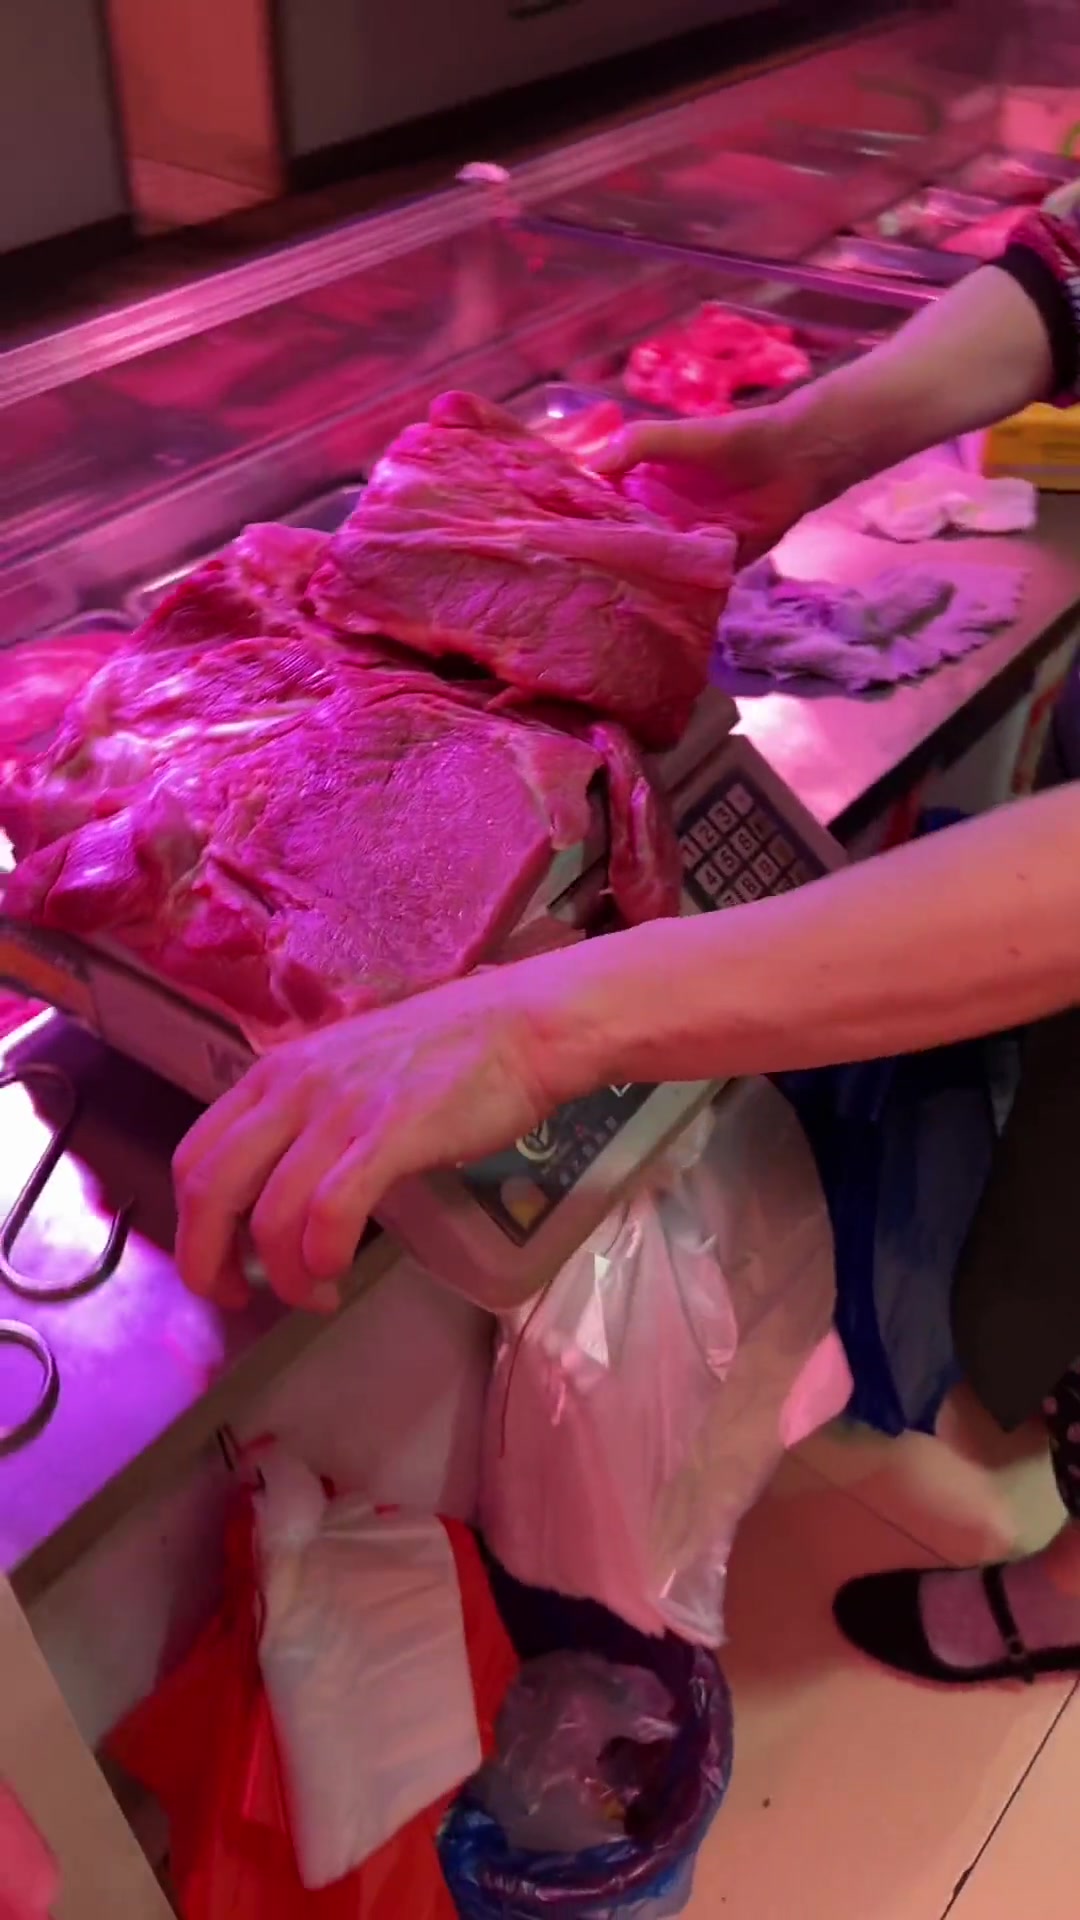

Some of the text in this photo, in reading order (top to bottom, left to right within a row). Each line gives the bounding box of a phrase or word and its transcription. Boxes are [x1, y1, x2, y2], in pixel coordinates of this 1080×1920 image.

[698, 826, 714, 843] 2
[715, 807, 732, 825] 3
[705, 833, 752, 885] 4 5 6
[742, 878, 757, 894] 8
